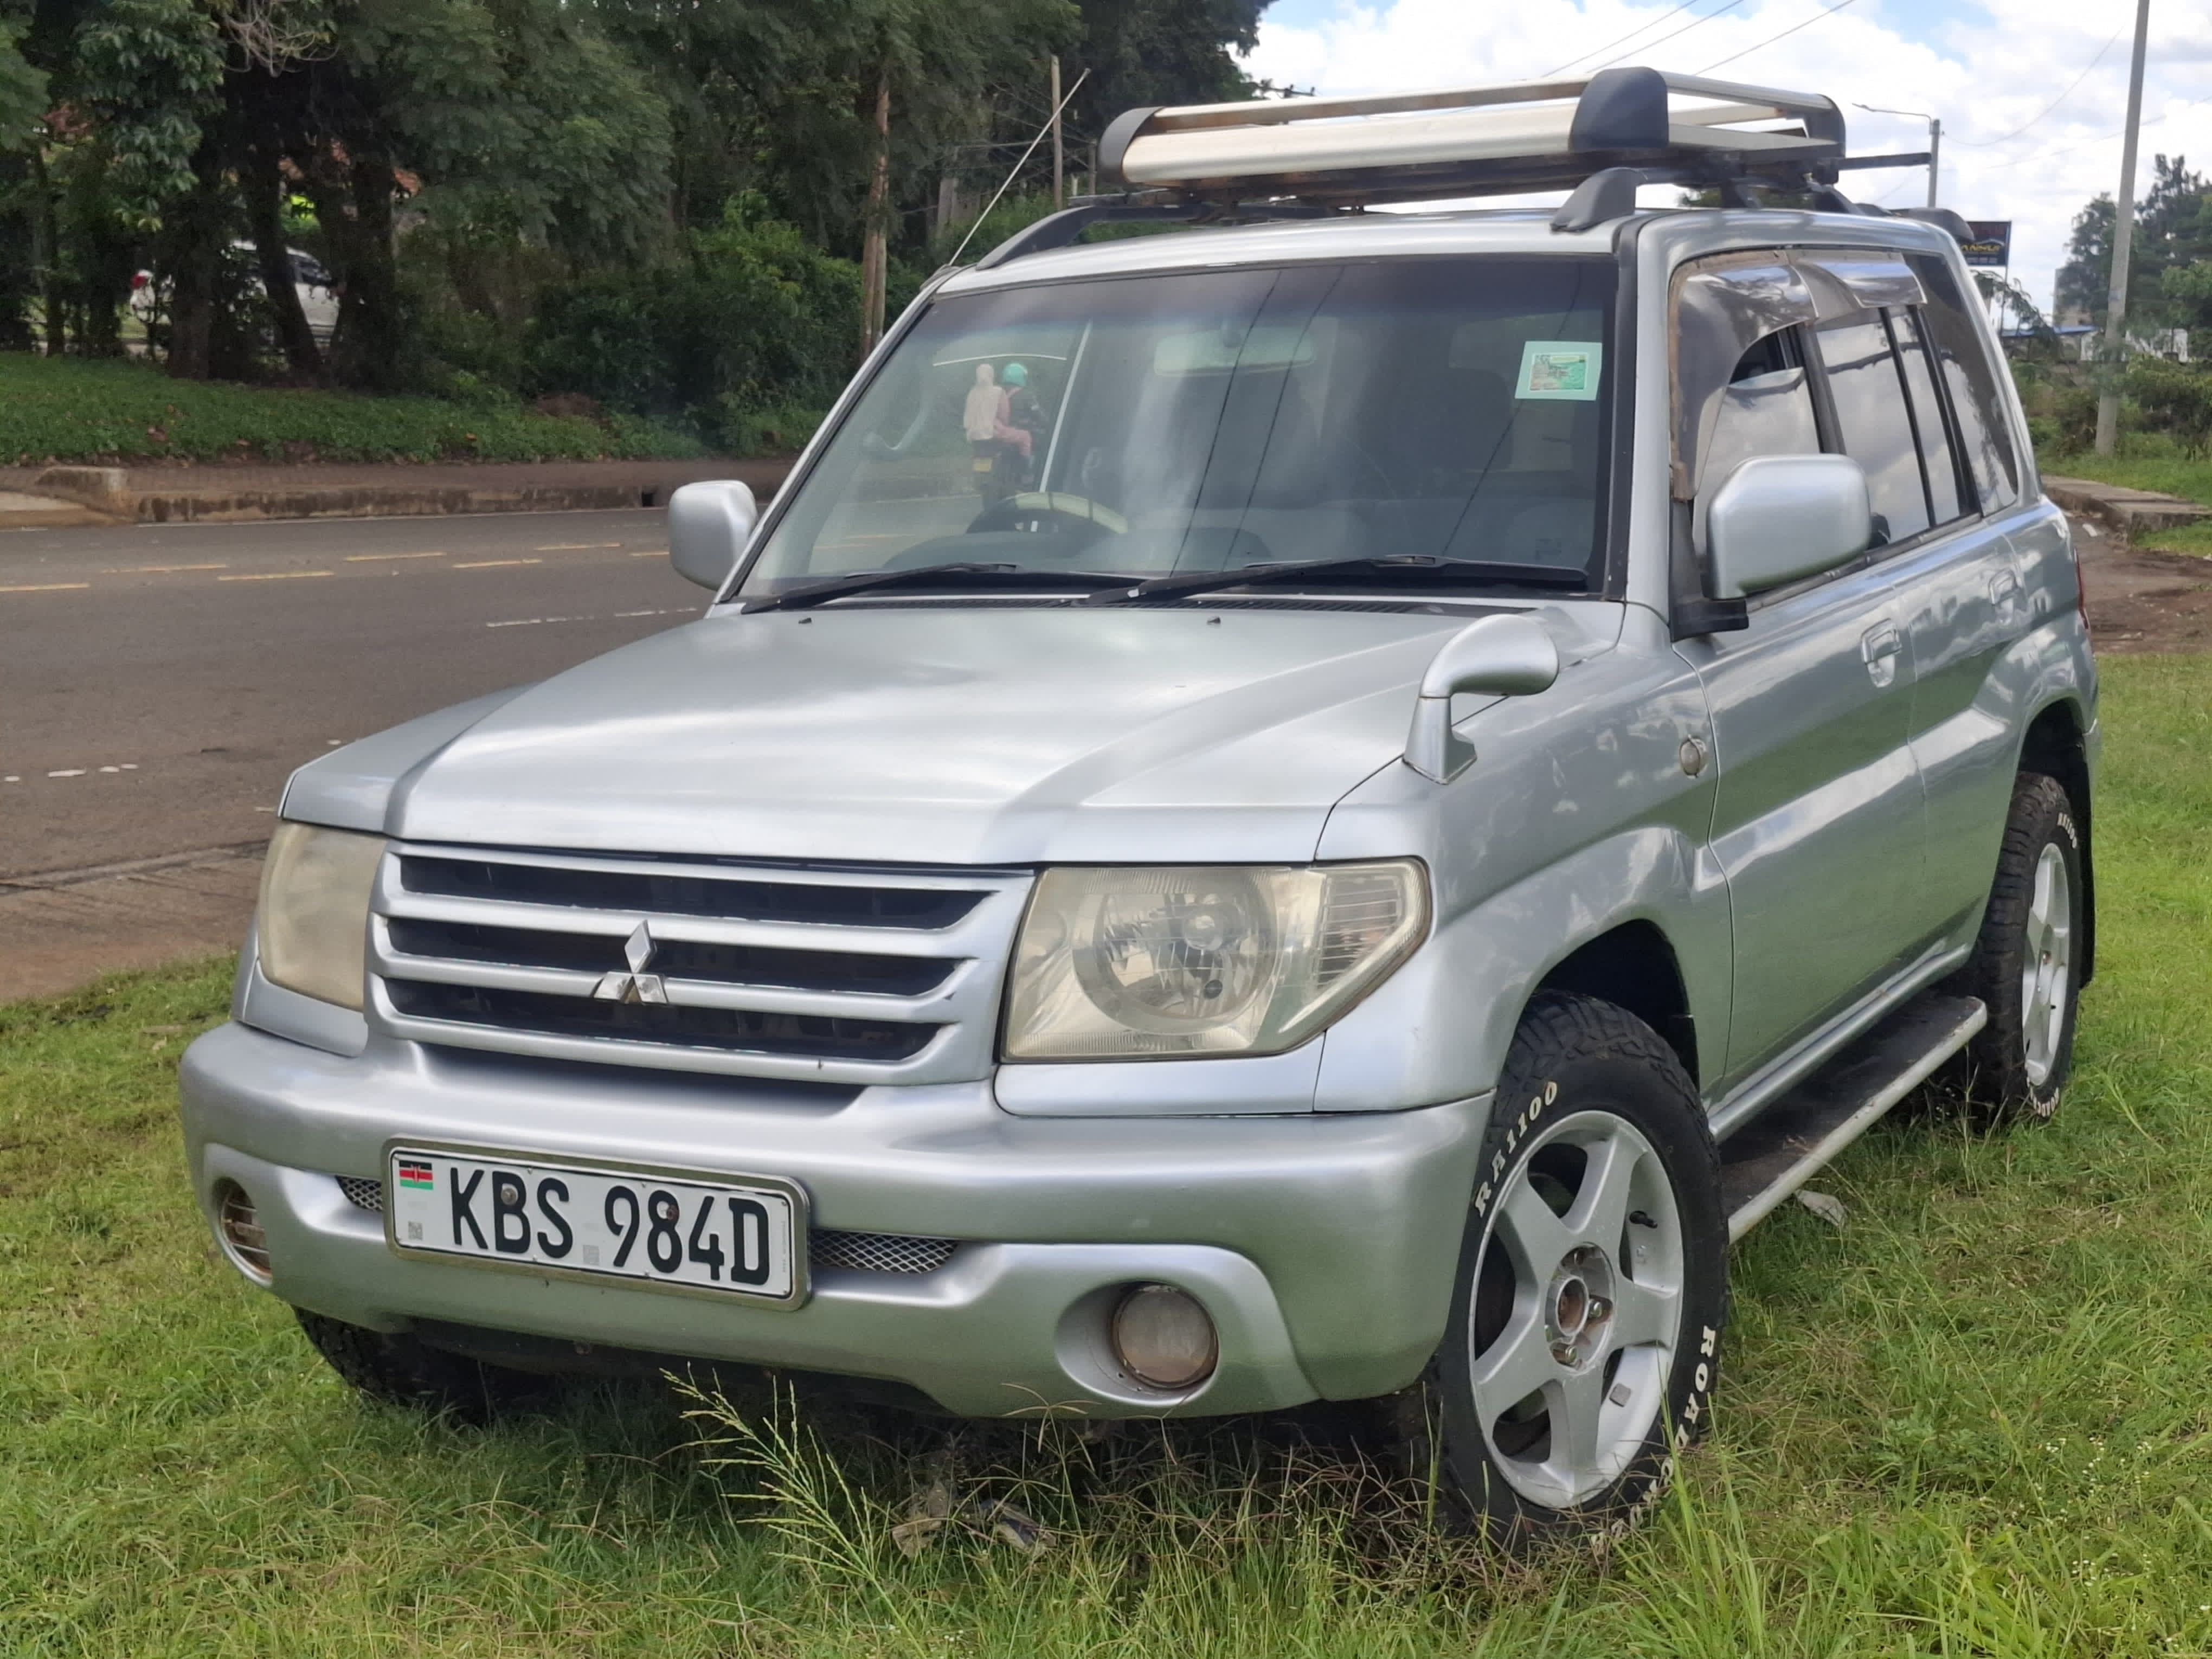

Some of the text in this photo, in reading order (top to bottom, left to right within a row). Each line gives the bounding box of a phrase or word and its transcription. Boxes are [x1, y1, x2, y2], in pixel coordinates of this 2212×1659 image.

[1475, 1081, 1558, 1218] RA1100
[450, 1167, 574, 1259] KBS
[605, 1185, 770, 1285] 984D
